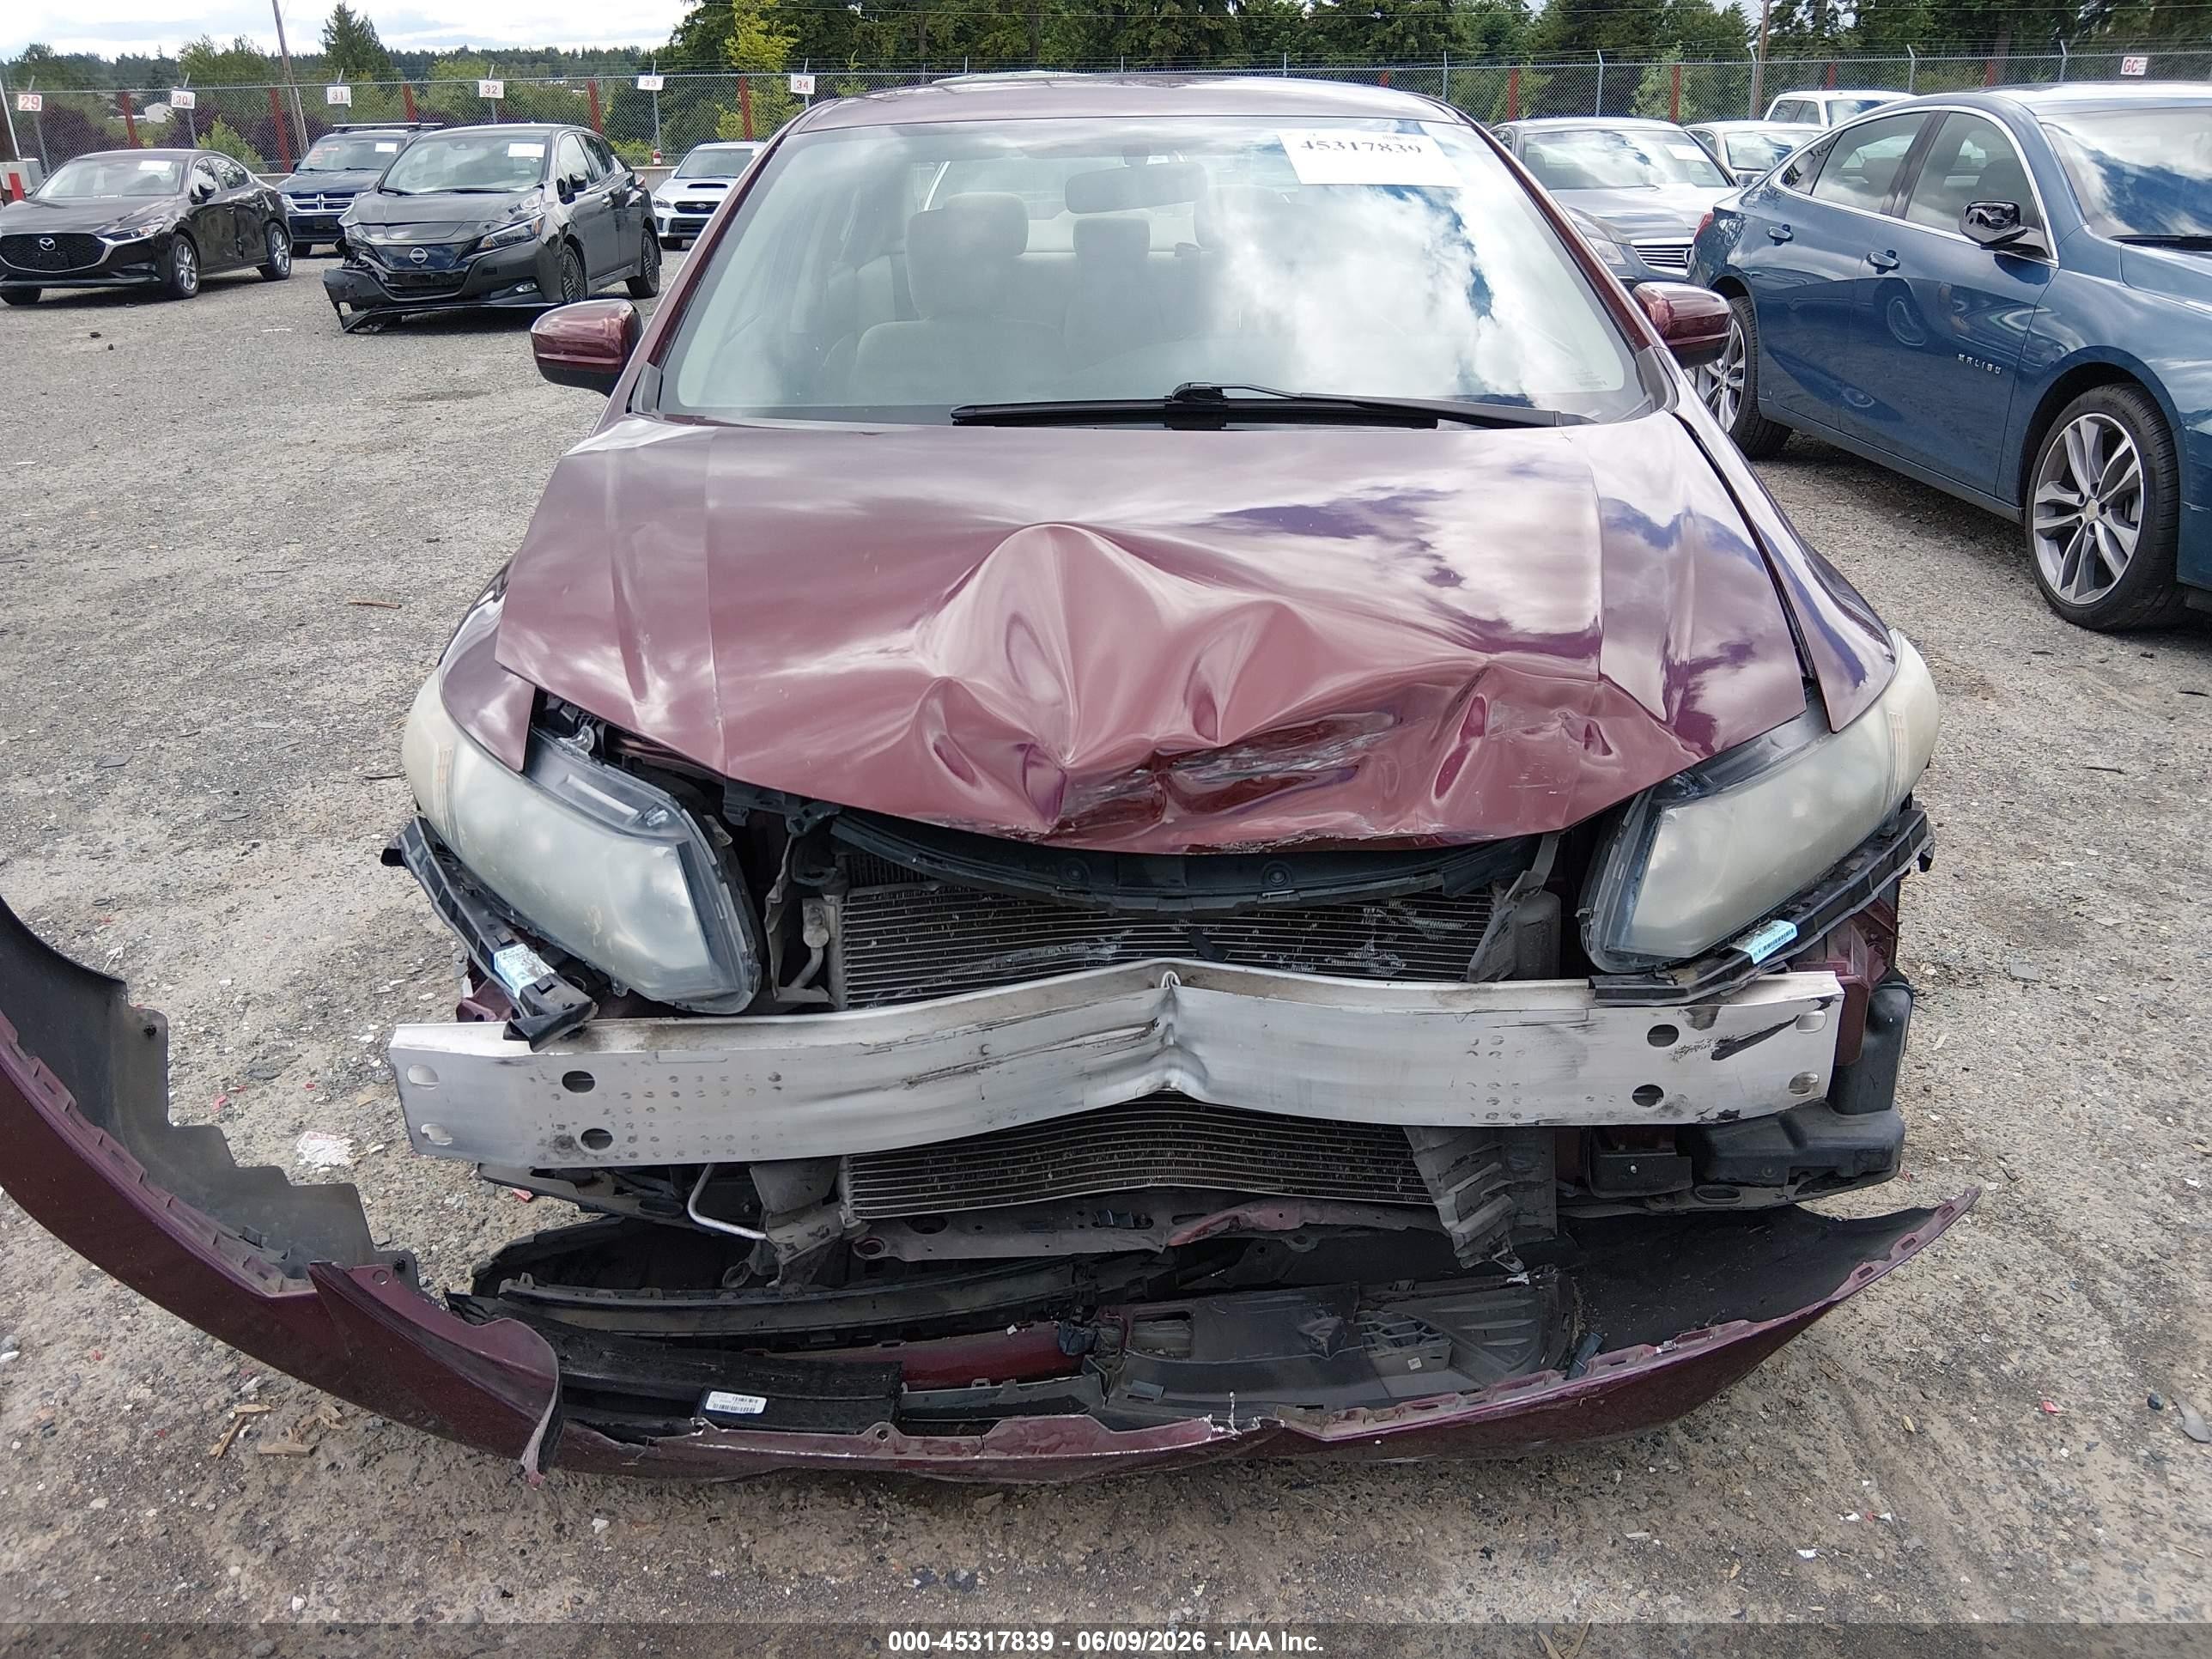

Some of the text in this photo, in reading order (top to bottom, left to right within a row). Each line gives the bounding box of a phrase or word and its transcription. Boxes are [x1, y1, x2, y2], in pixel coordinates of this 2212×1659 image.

[2124, 59, 2138, 73] GC
[484, 84, 498, 94] 32
[796, 79, 809, 90] 34
[176, 95, 188, 105] 30
[332, 91, 343, 100] 31
[20, 95, 40, 110] 29
[1300, 140, 1422, 154] 45317839
[1958, 353, 2002, 374] MALIBU
